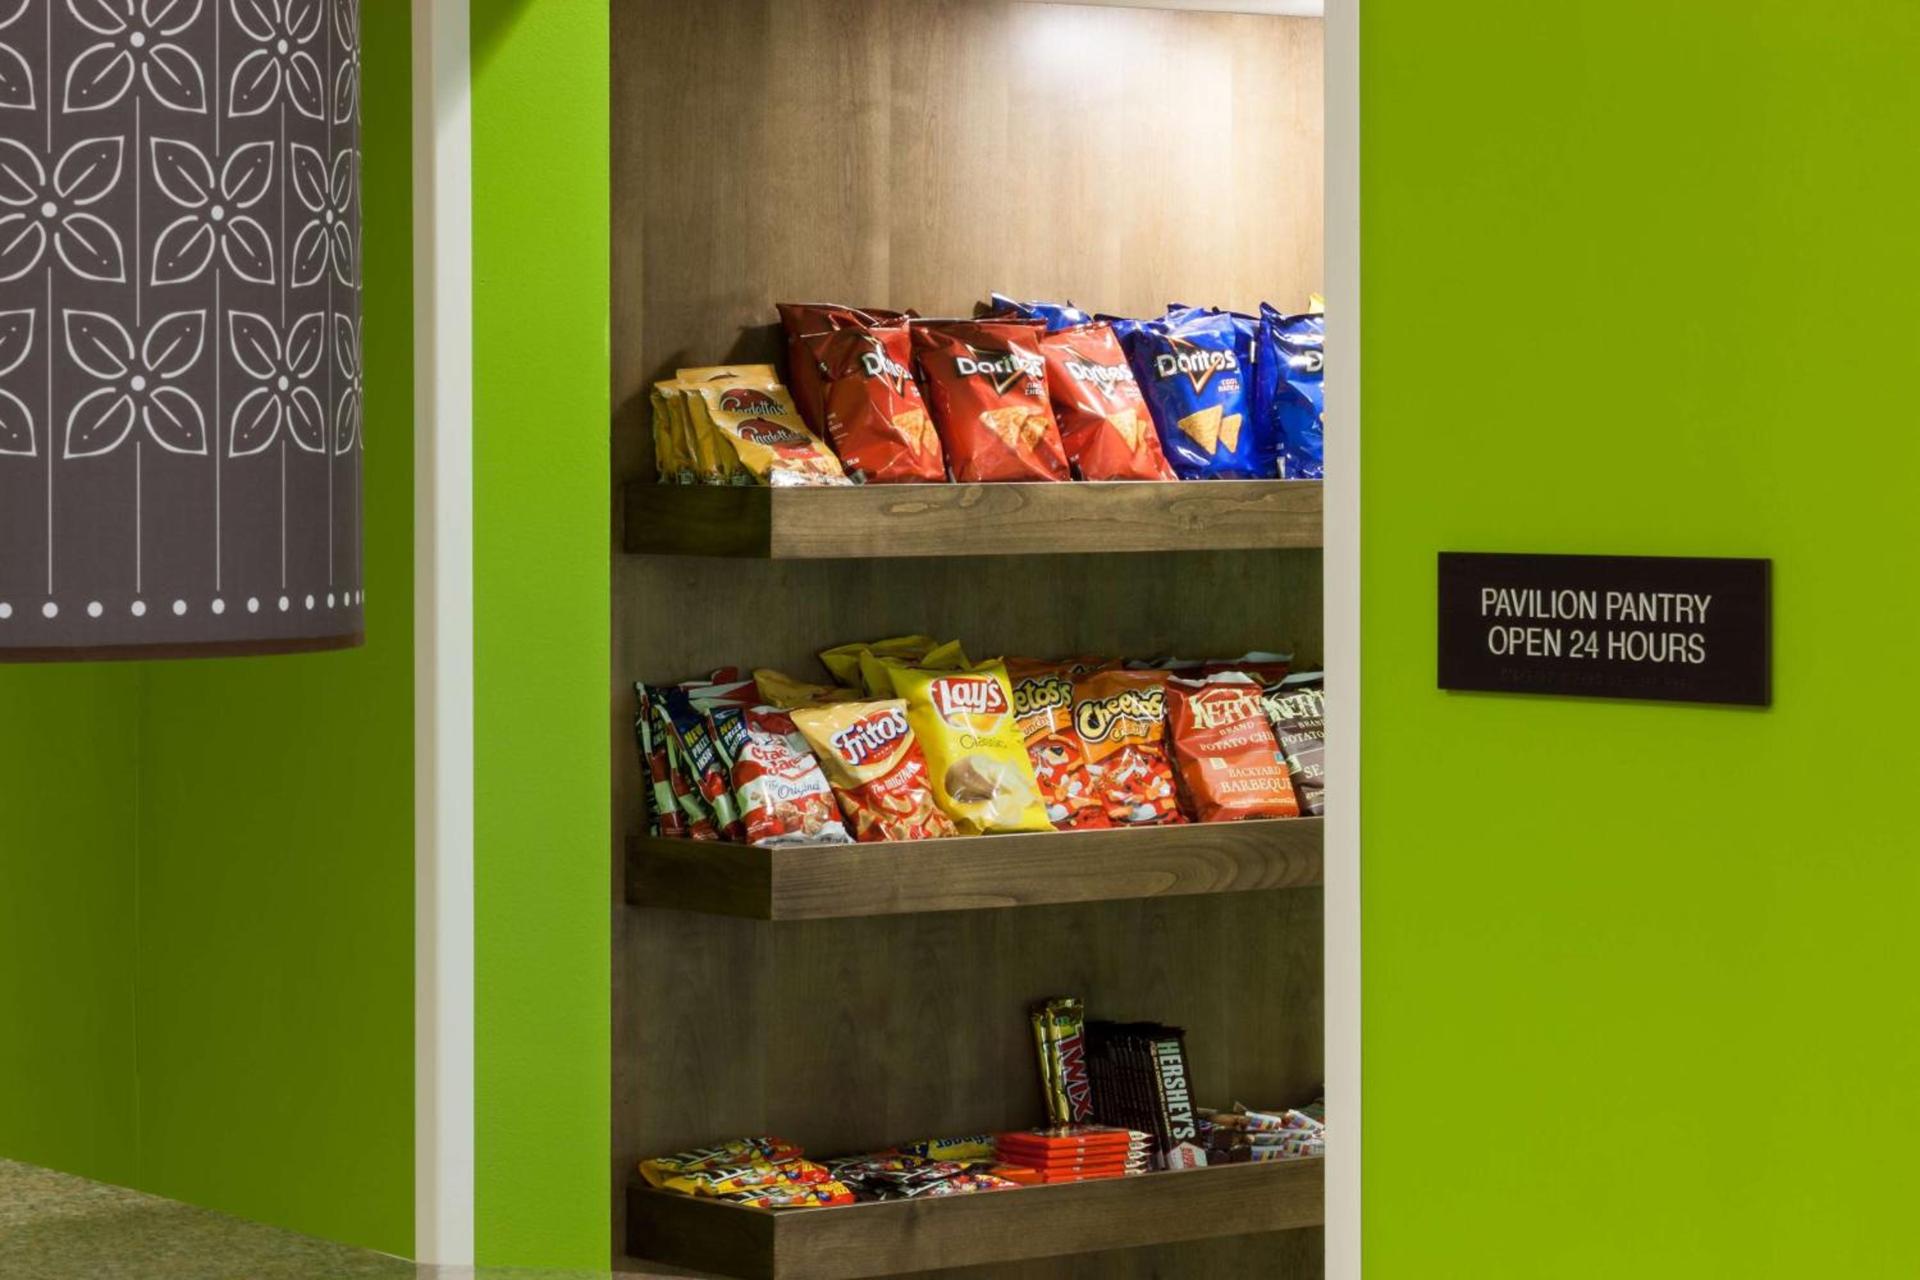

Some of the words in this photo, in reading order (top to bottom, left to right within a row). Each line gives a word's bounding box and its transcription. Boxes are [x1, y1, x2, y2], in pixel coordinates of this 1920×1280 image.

[956, 356, 1044, 377] Doritos
[1157, 349, 1236, 377] Doritos
[1482, 588, 1597, 619] PAVILION
[1606, 592, 1711, 624] PANTRY
[1488, 626, 1561, 656] OPEN
[1569, 630, 1599, 658] 24
[1608, 631, 1707, 664] HOURS
[939, 678, 1001, 715] Lay's
[1080, 693, 1162, 738] Cheetos
[1219, 721, 1255, 736] BRAND
[830, 708, 908, 765] Fritos
[1200, 737, 1248, 751] POTATO
[1228, 766, 1281, 777] BACKYARD
[777, 783, 821, 799] Original
[1055, 1022, 1094, 1121] TWIX
[1157, 1041, 1196, 1140] HERSHEY'S
